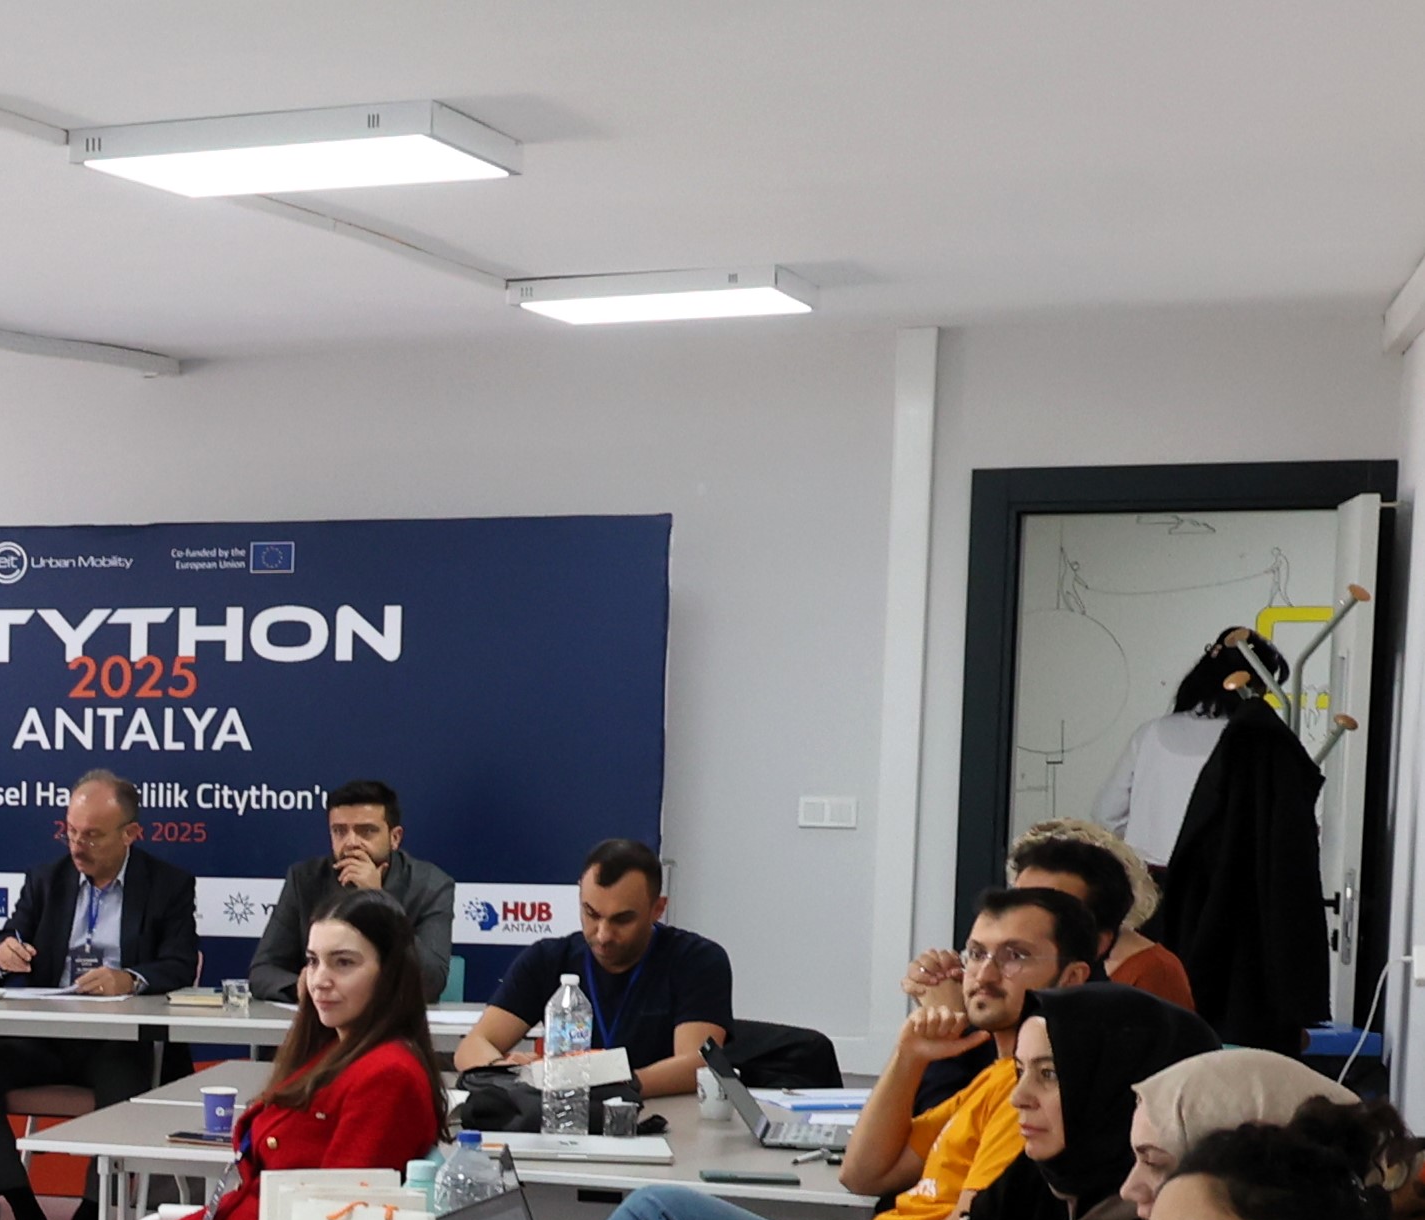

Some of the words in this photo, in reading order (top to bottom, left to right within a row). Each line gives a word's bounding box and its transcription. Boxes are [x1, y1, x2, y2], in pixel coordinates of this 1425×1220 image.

[171, 547, 217, 558] Co-funded
[218, 547, 230, 560] by
[231, 547, 246, 557] the
[30, 556, 76, 569] Urban
[77, 555, 134, 570] Mobility
[175, 560, 218, 572] European
[219, 560, 246, 569] Union
[68, 655, 198, 699] 2025
[12, 707, 253, 752] ANTALYA
[152, 822, 207, 842] 2025
[502, 901, 553, 922] HUB
[502, 922, 553, 934] ANTALYA
